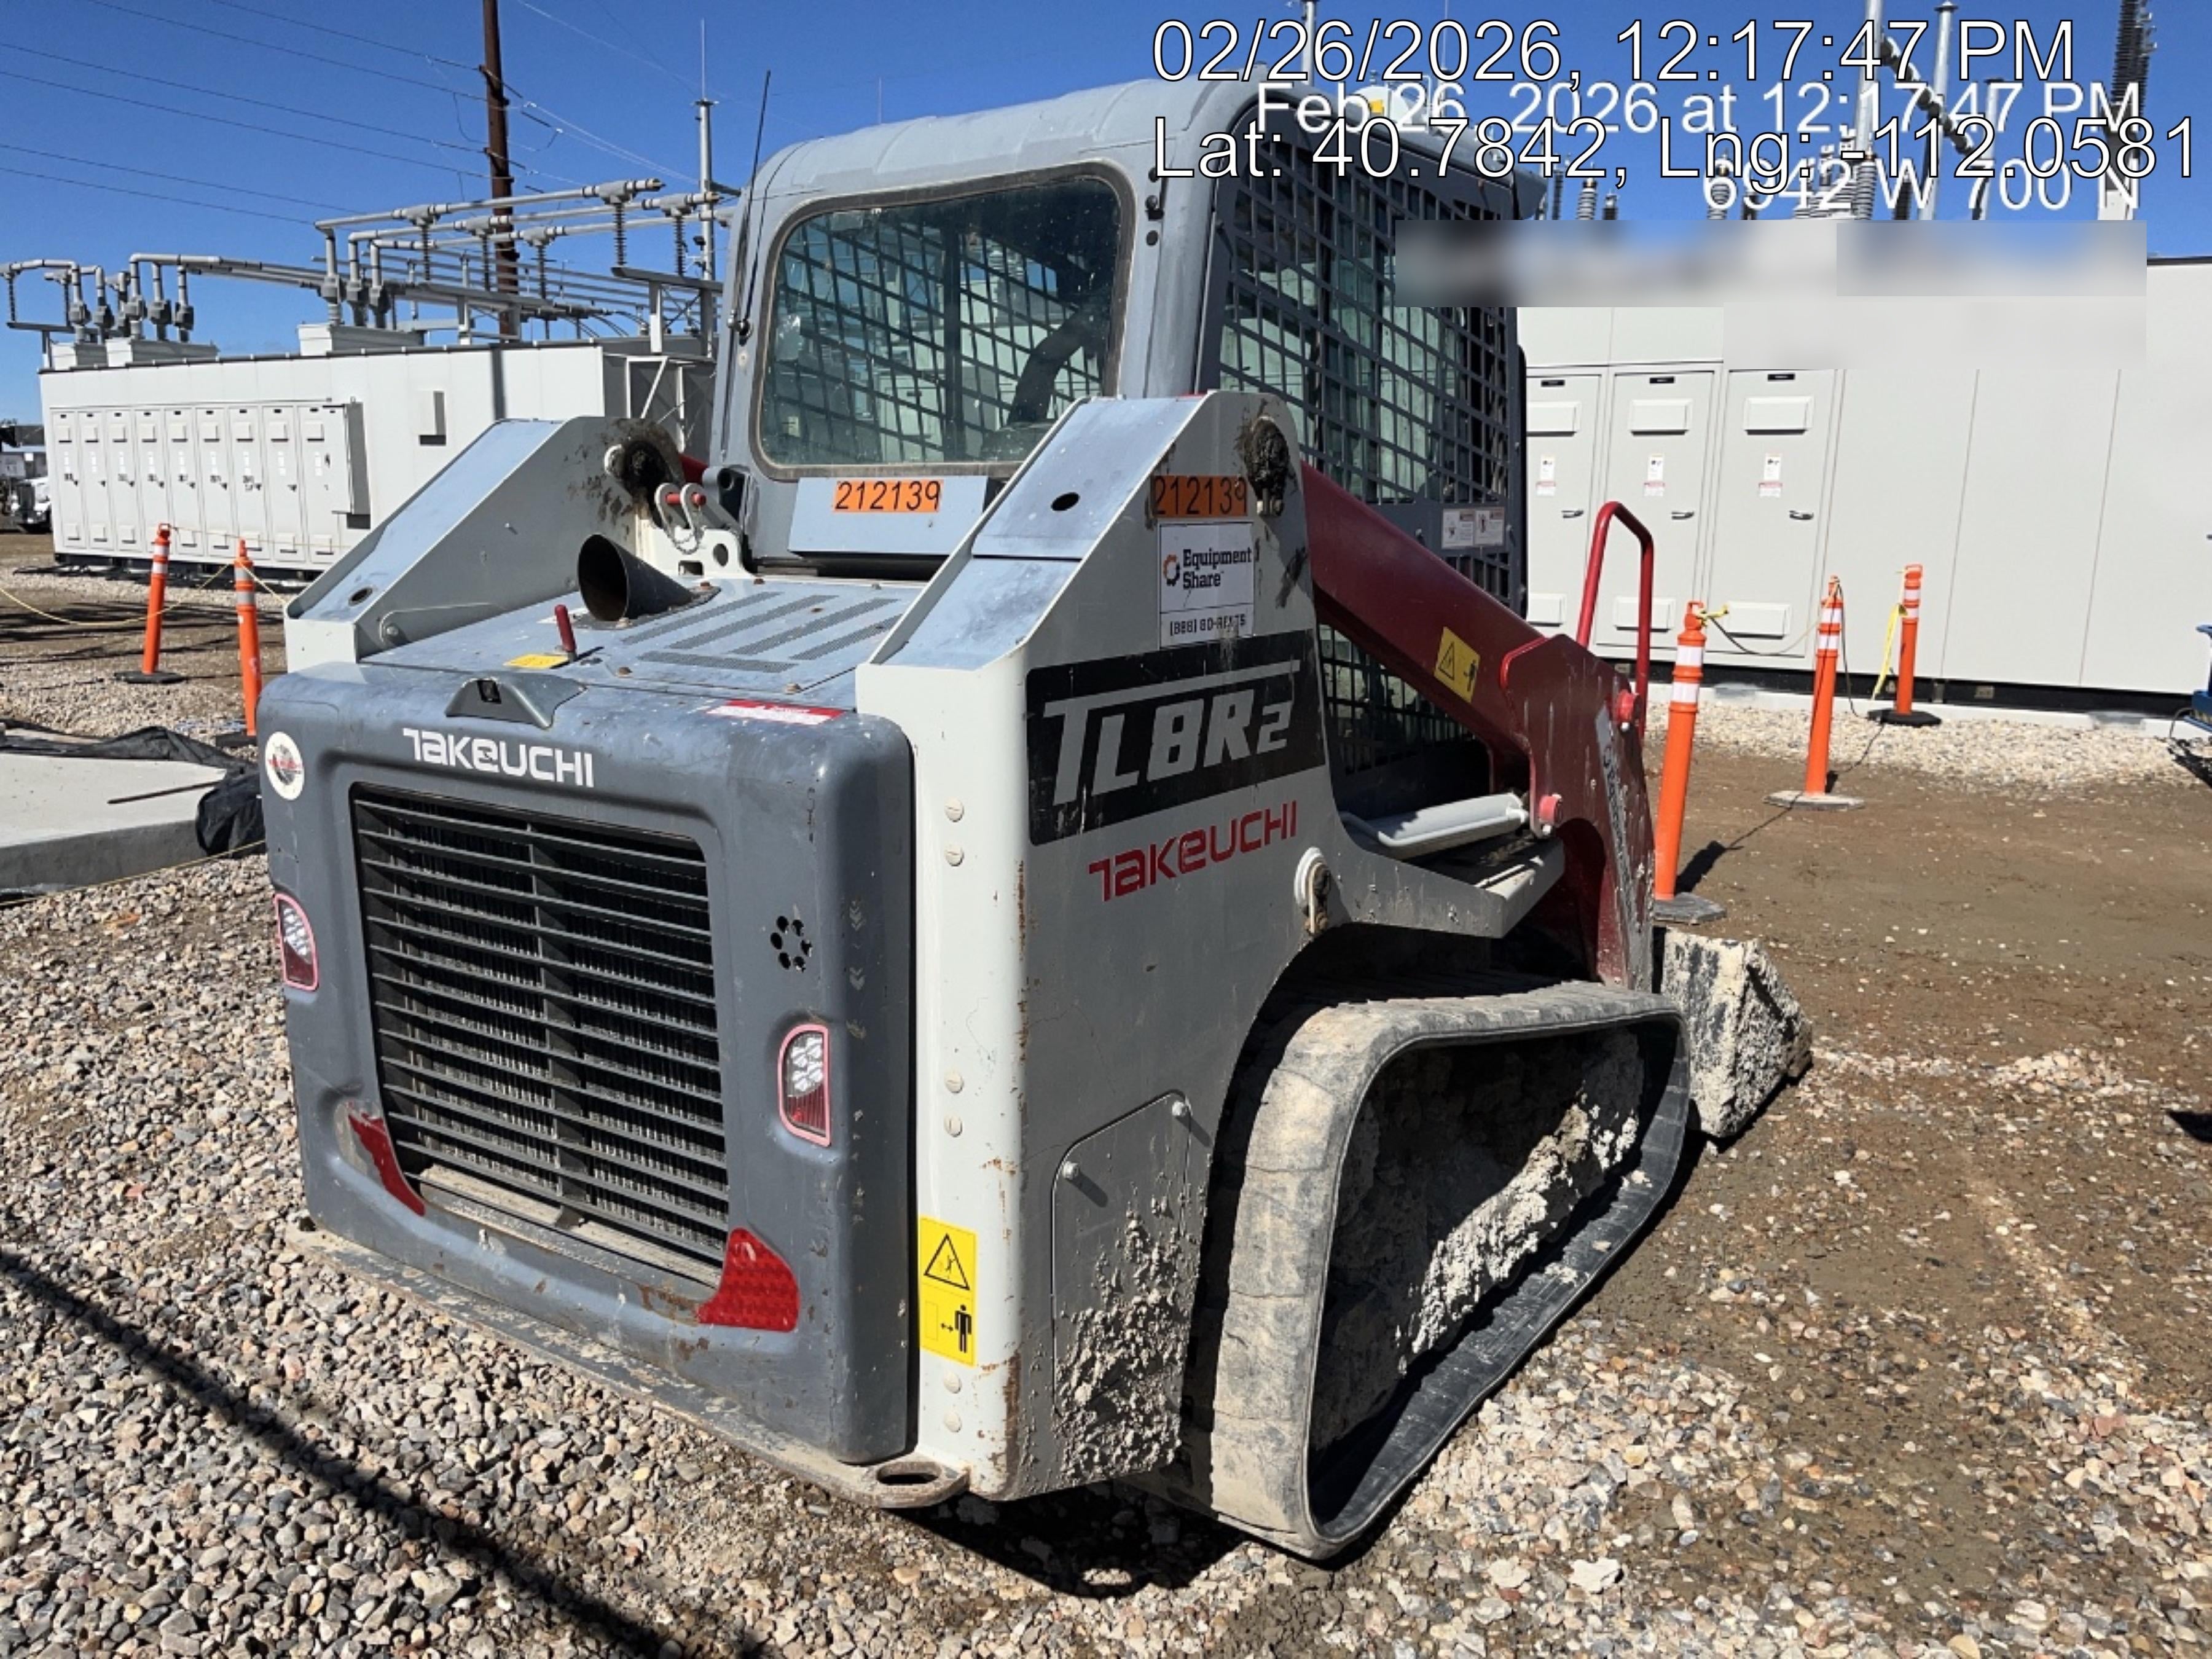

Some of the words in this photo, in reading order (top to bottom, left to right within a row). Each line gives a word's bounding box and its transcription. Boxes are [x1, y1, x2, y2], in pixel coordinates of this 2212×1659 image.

[834, 480, 942, 511] 212139
[1153, 476, 1247, 516] 212139
[1183, 546, 1252, 570] Equipment
[1183, 571, 1221, 590] Share
[1043, 659, 1301, 807] TL8R2
[402, 728, 595, 788] TAKEUCHI
[1088, 800, 1297, 902] TAKEUCHI
